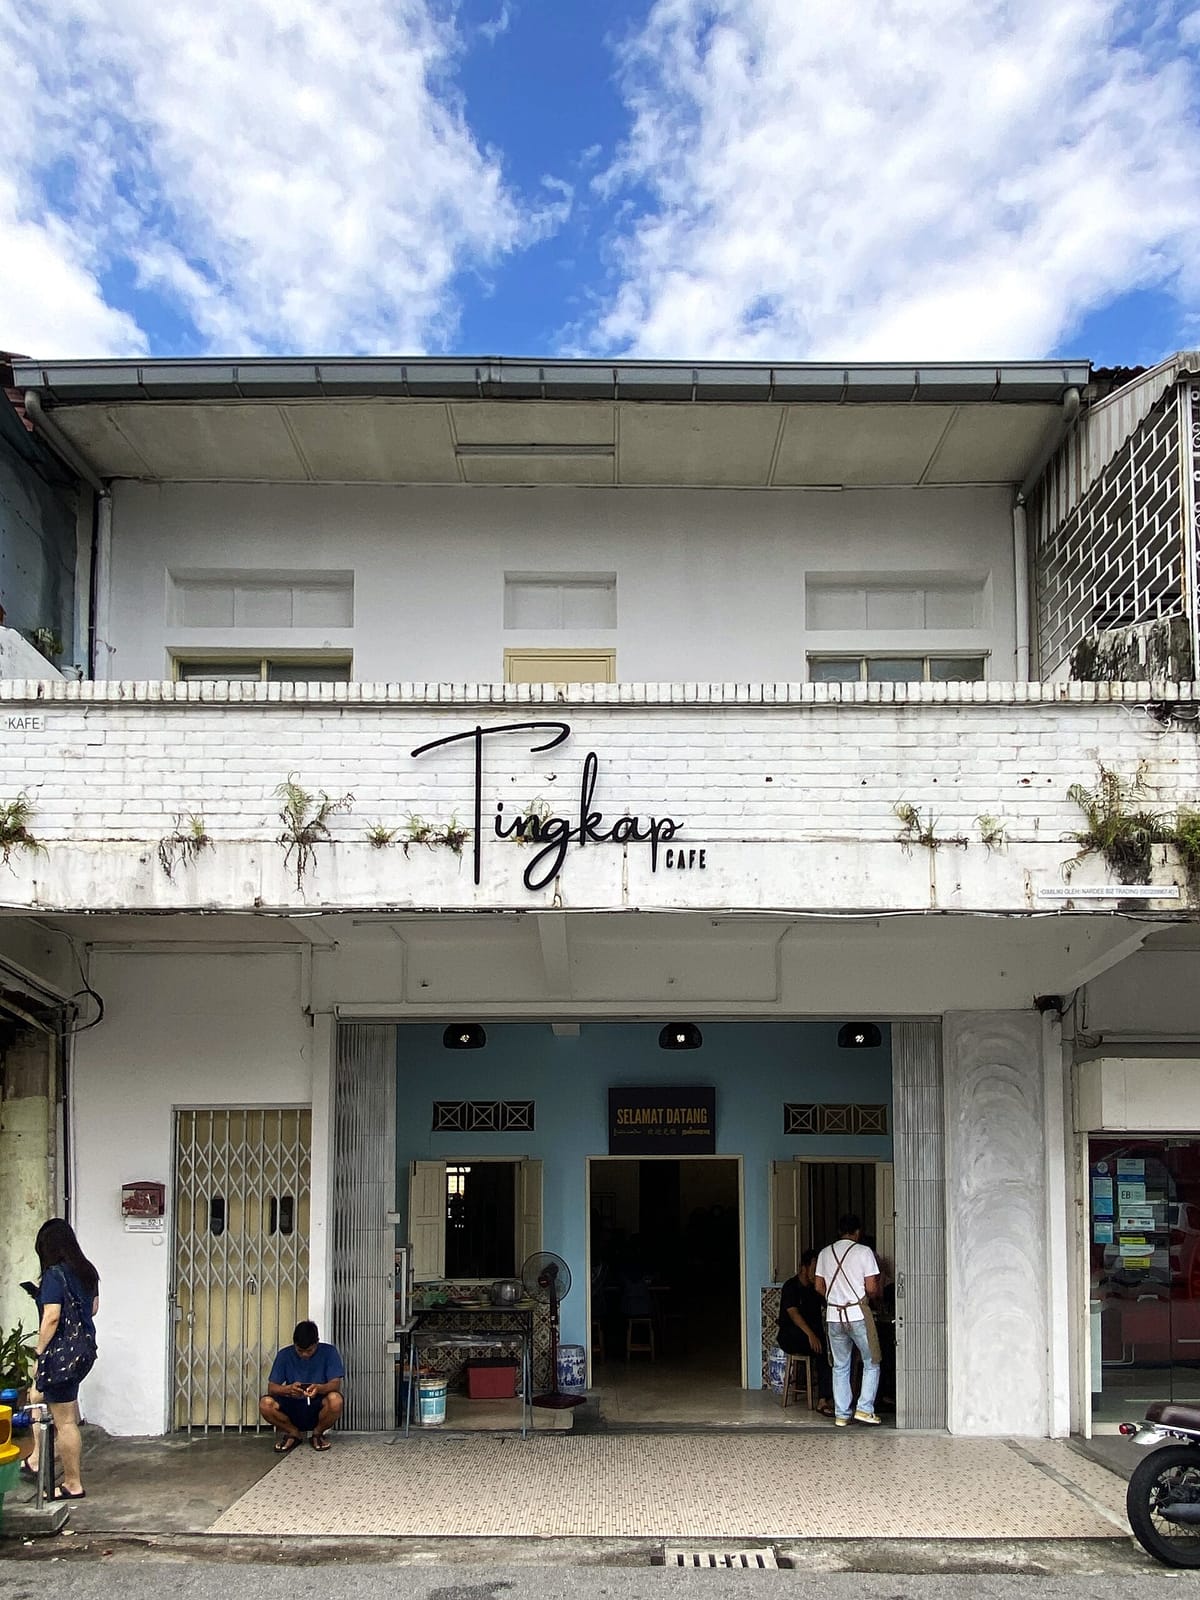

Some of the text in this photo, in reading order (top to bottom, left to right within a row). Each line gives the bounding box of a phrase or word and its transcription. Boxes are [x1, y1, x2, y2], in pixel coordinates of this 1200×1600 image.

[8, 717, 40, 730] KAFE
[410, 722, 684, 890] Tingkap
[666, 849, 706, 869] CAFE
[616, 1108, 707, 1124] SELAMAT DATANG
